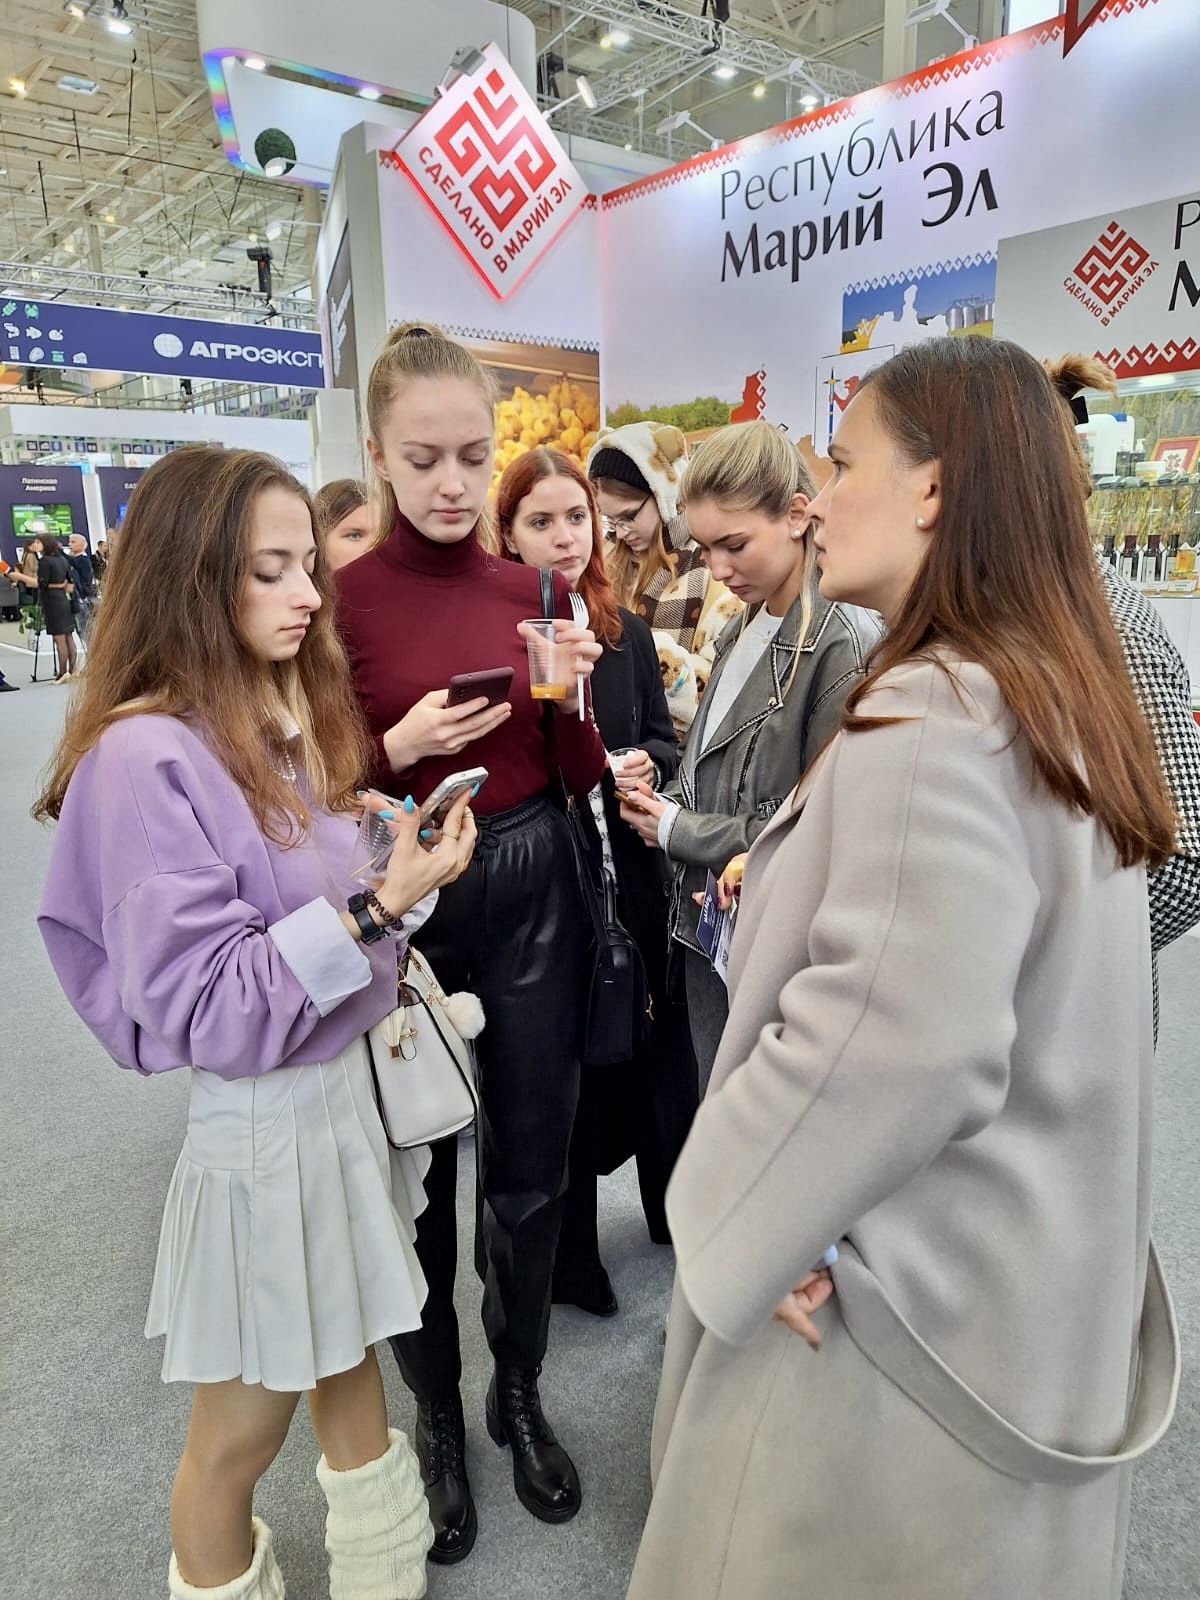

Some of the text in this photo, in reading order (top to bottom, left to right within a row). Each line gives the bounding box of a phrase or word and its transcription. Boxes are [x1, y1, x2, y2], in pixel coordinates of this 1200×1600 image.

[418, 146, 495, 250] СДЕЛАНО
[720, 89, 1005, 220] Республика
[493, 177, 572, 273] В МАРИЙ ЭЛ
[720, 161, 999, 283] Марий Эл
[1063, 276, 1103, 318] СДЕЛАНО
[1100, 260, 1160, 327] В МАРИЙ ЭЛ
[25, 484, 56, 492] Америка
